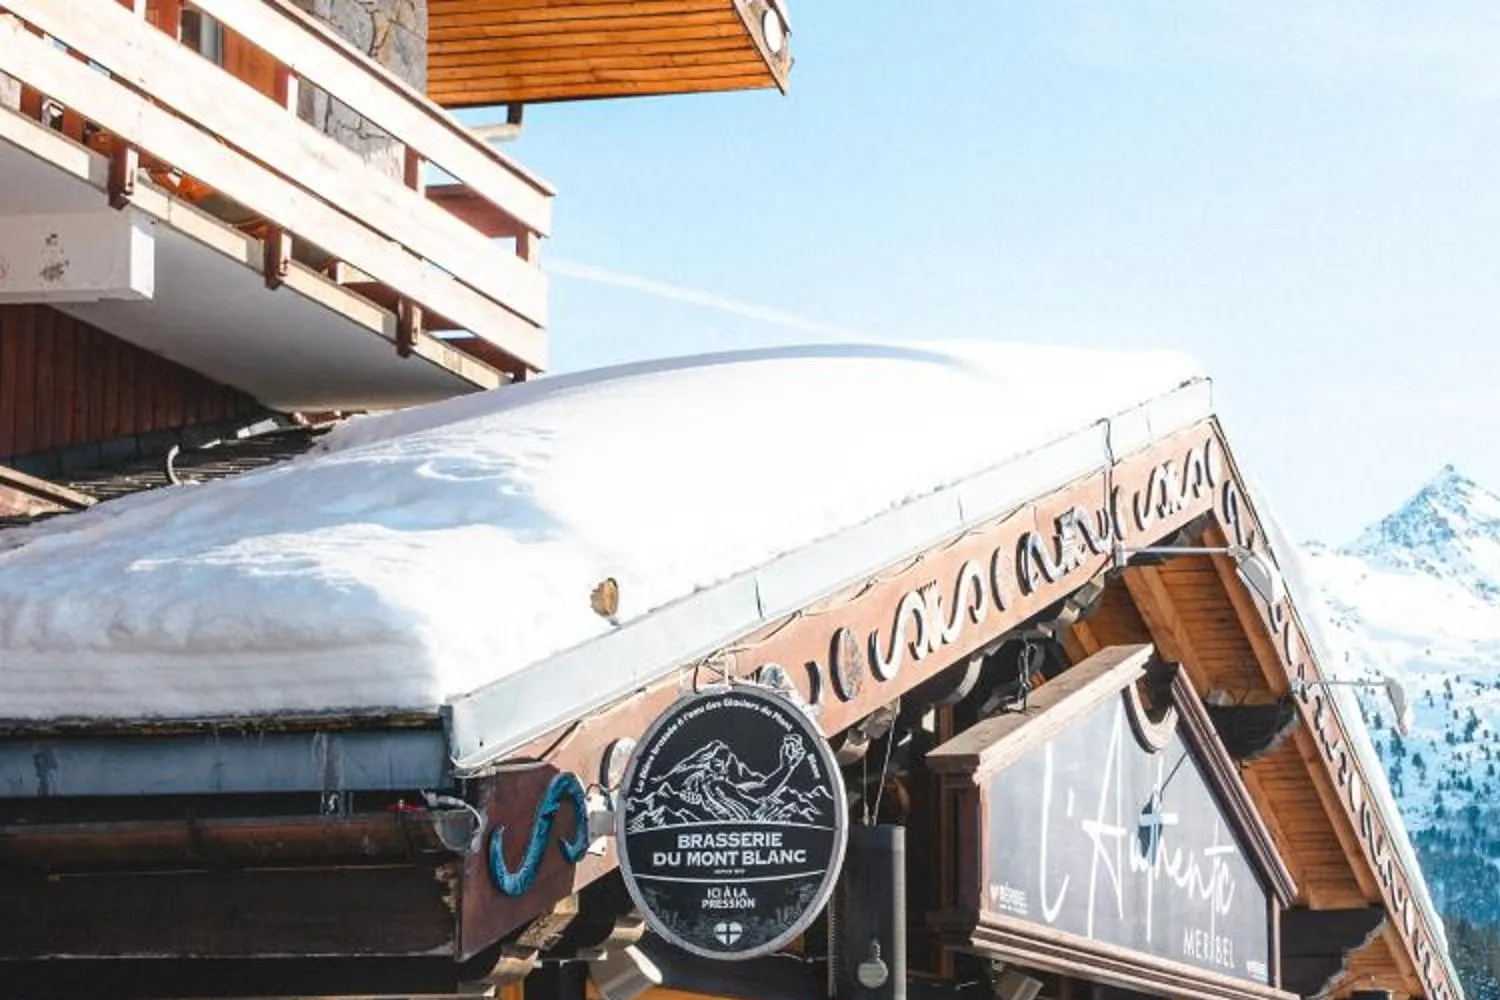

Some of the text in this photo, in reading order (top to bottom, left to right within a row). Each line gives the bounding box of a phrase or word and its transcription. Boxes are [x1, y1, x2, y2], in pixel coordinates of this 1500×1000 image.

[650, 723, 678, 754] brassée
[706, 701, 722, 711] des
[723, 698, 760, 710] Glaciers
[760, 706, 773, 717] du
[772, 712, 793, 733] Mont
[807, 753, 821, 779] Blanc
[677, 831, 784, 850] BRASSERIE
[652, 849, 807, 867] DU MONT BLANC
[723, 885, 733, 899] À
[733, 887, 748, 899] LA
[701, 898, 756, 909] PRESSION
